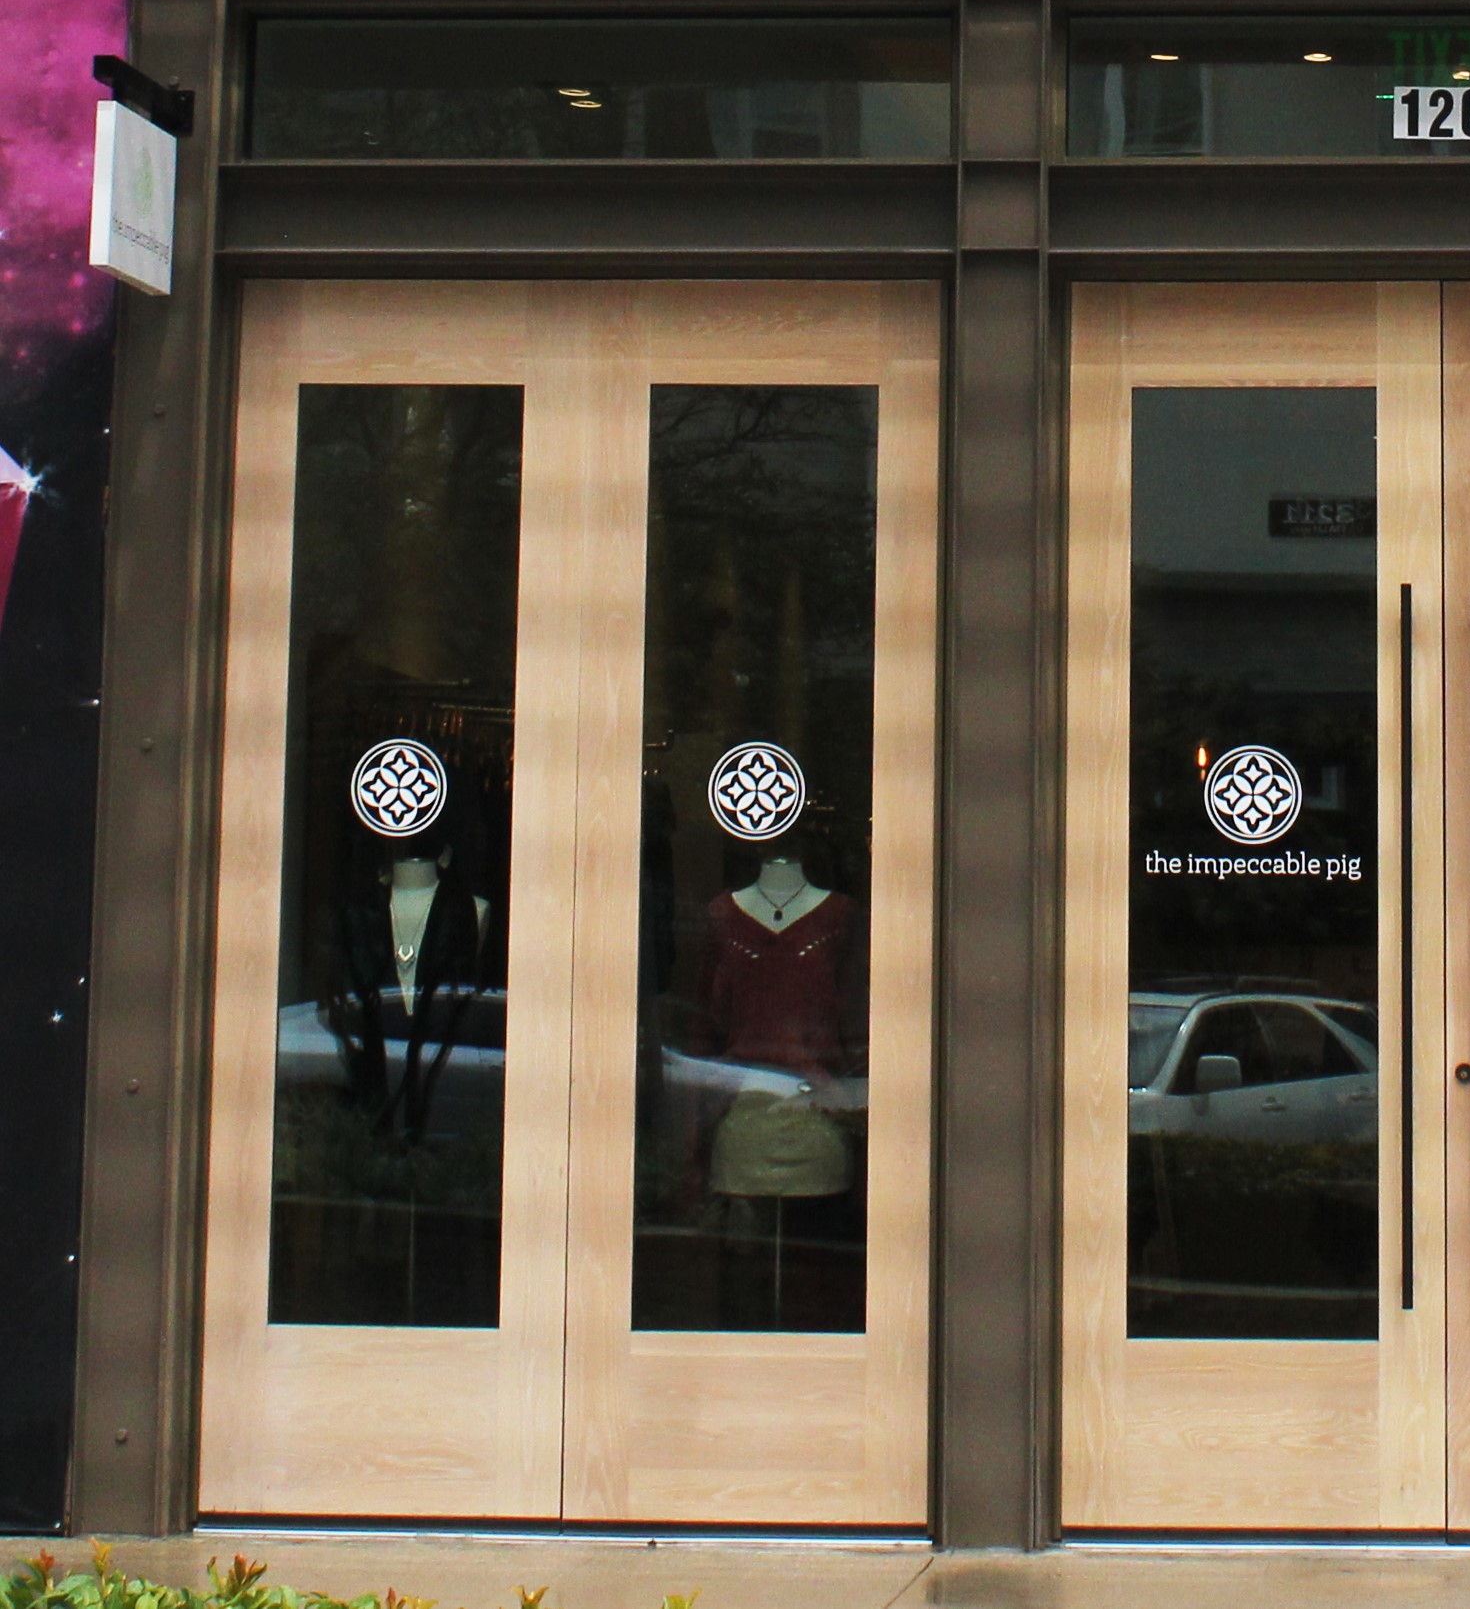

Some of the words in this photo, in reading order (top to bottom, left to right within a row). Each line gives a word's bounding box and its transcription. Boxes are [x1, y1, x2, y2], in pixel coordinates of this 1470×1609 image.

[1145, 849, 1182, 874] the
[1187, 850, 1321, 880] impeccable
[1325, 854, 1362, 881] pig
